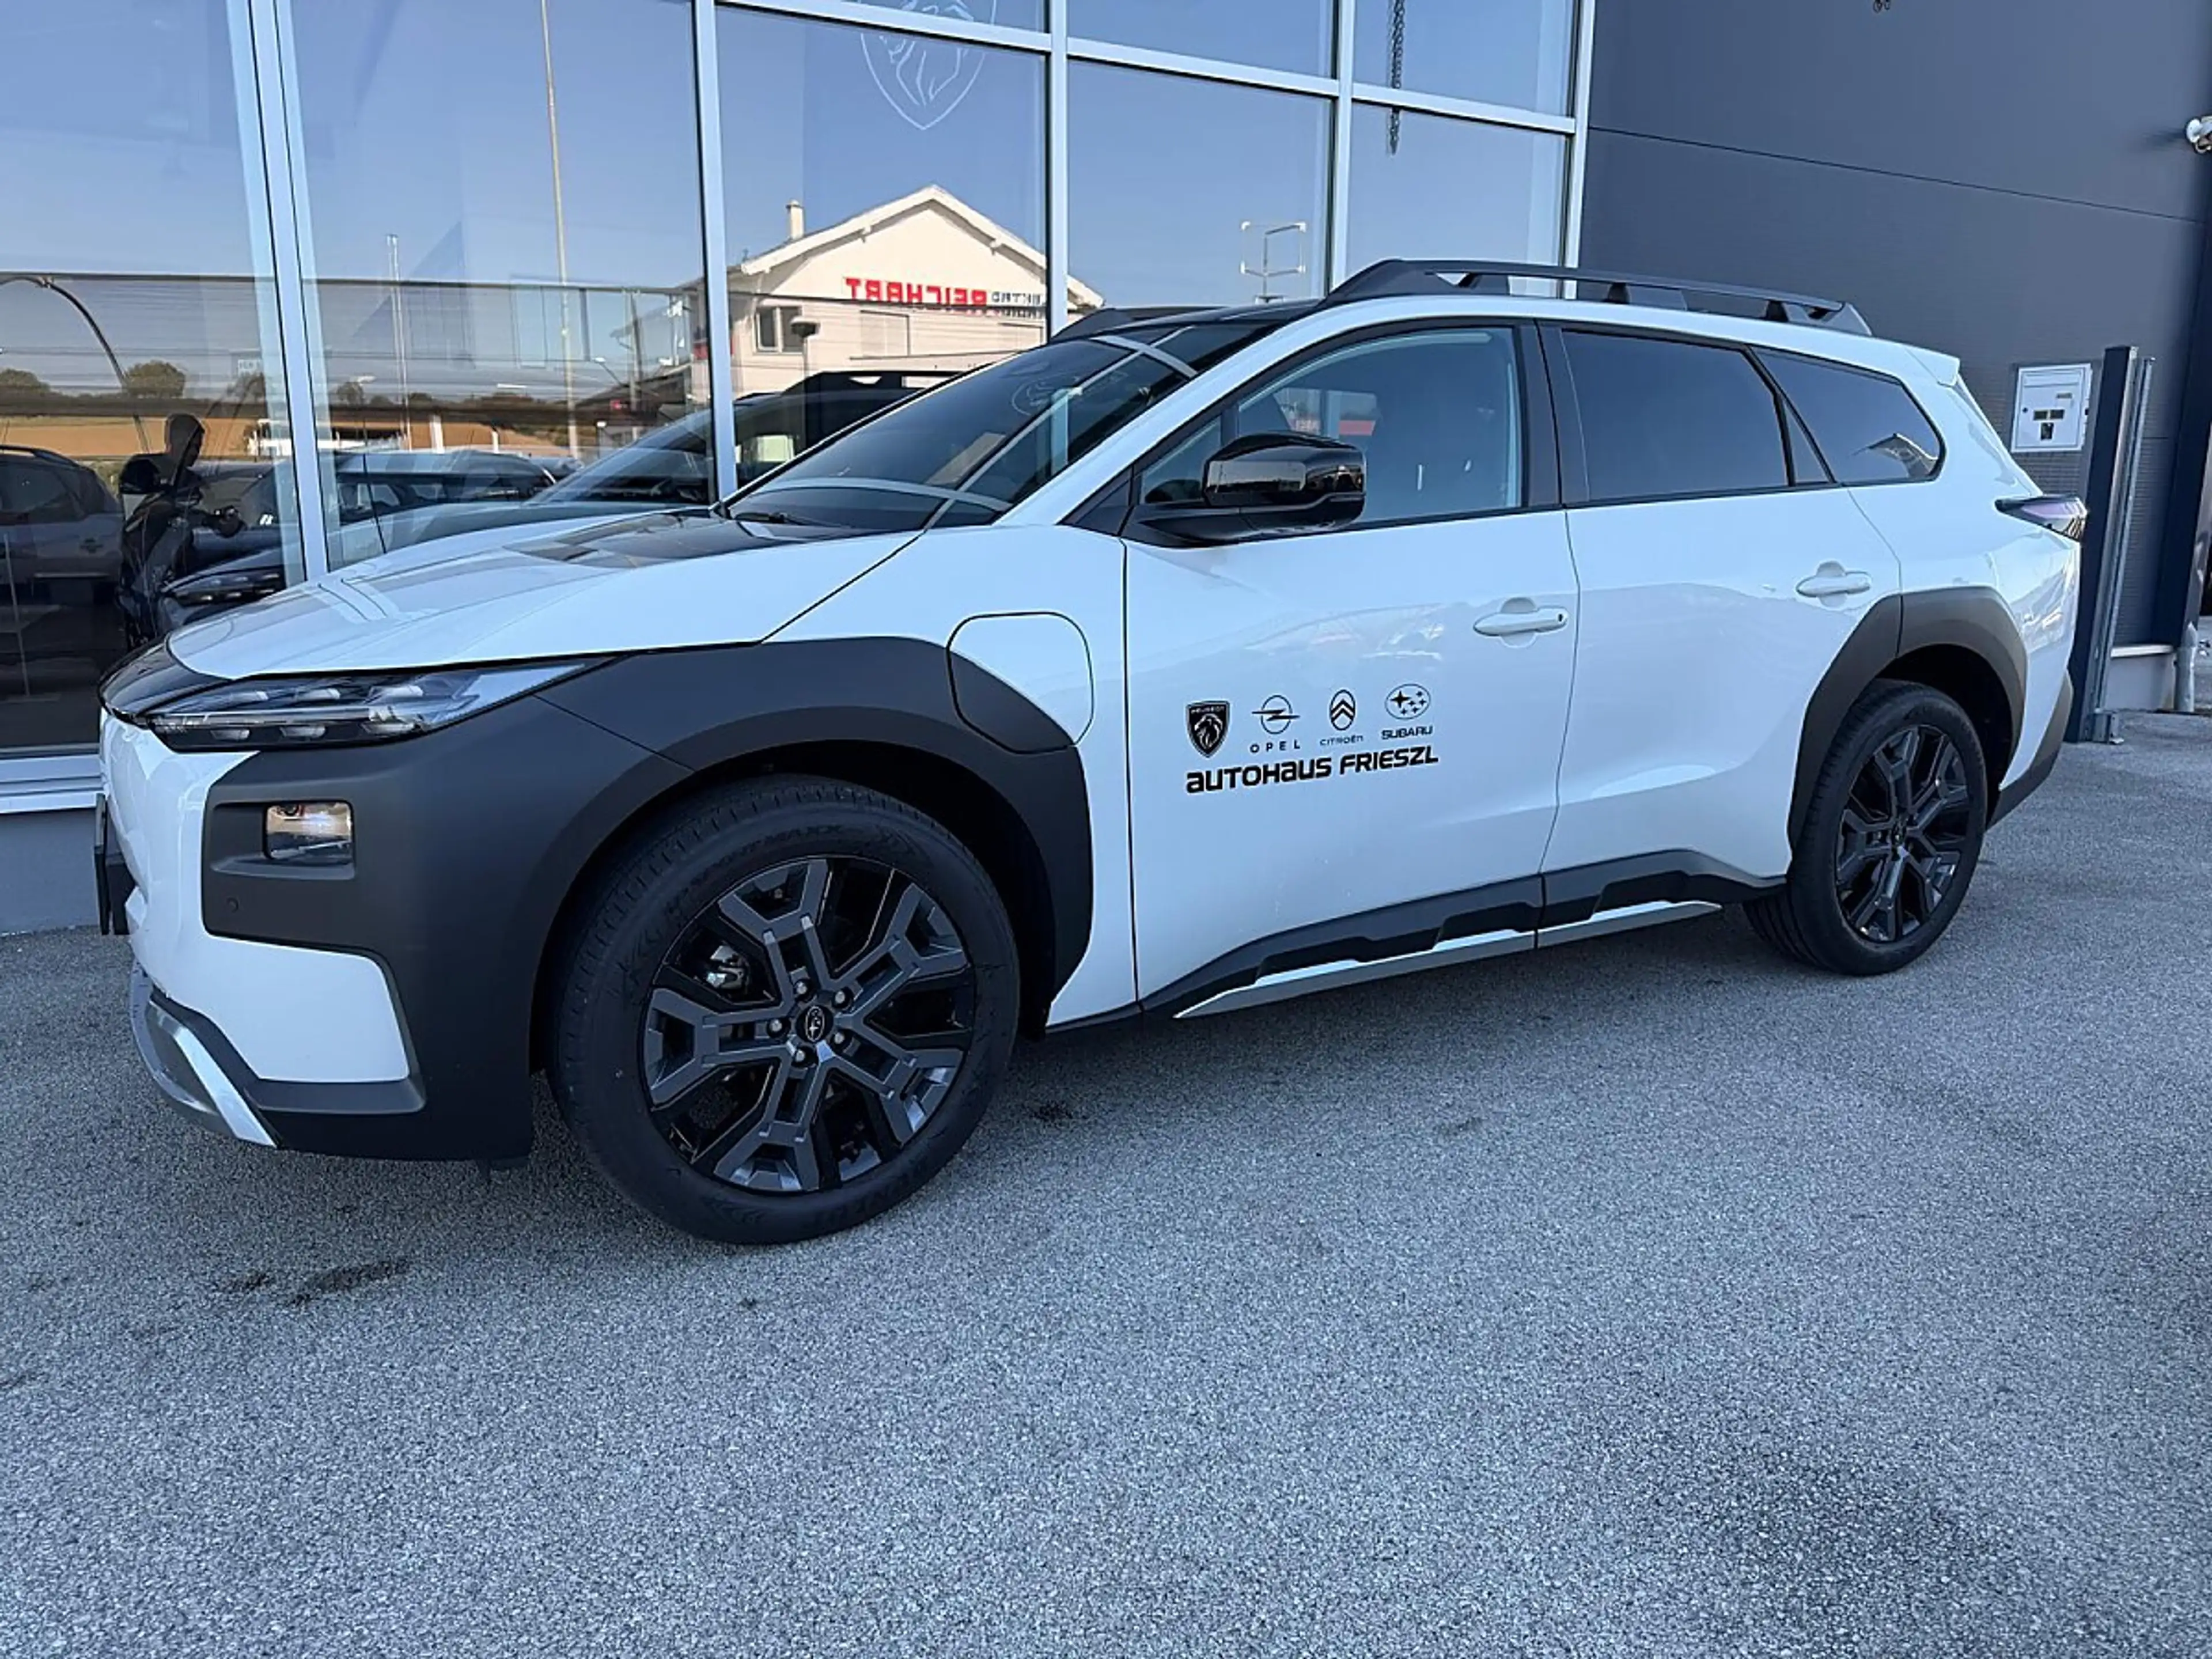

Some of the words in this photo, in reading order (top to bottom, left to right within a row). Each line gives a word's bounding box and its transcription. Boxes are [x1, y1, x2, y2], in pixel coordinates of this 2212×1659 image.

[1382, 725, 1433, 740] SUBARU
[1249, 739, 1300, 753] OPEL
[1339, 746, 1438, 775] FRIESZL
